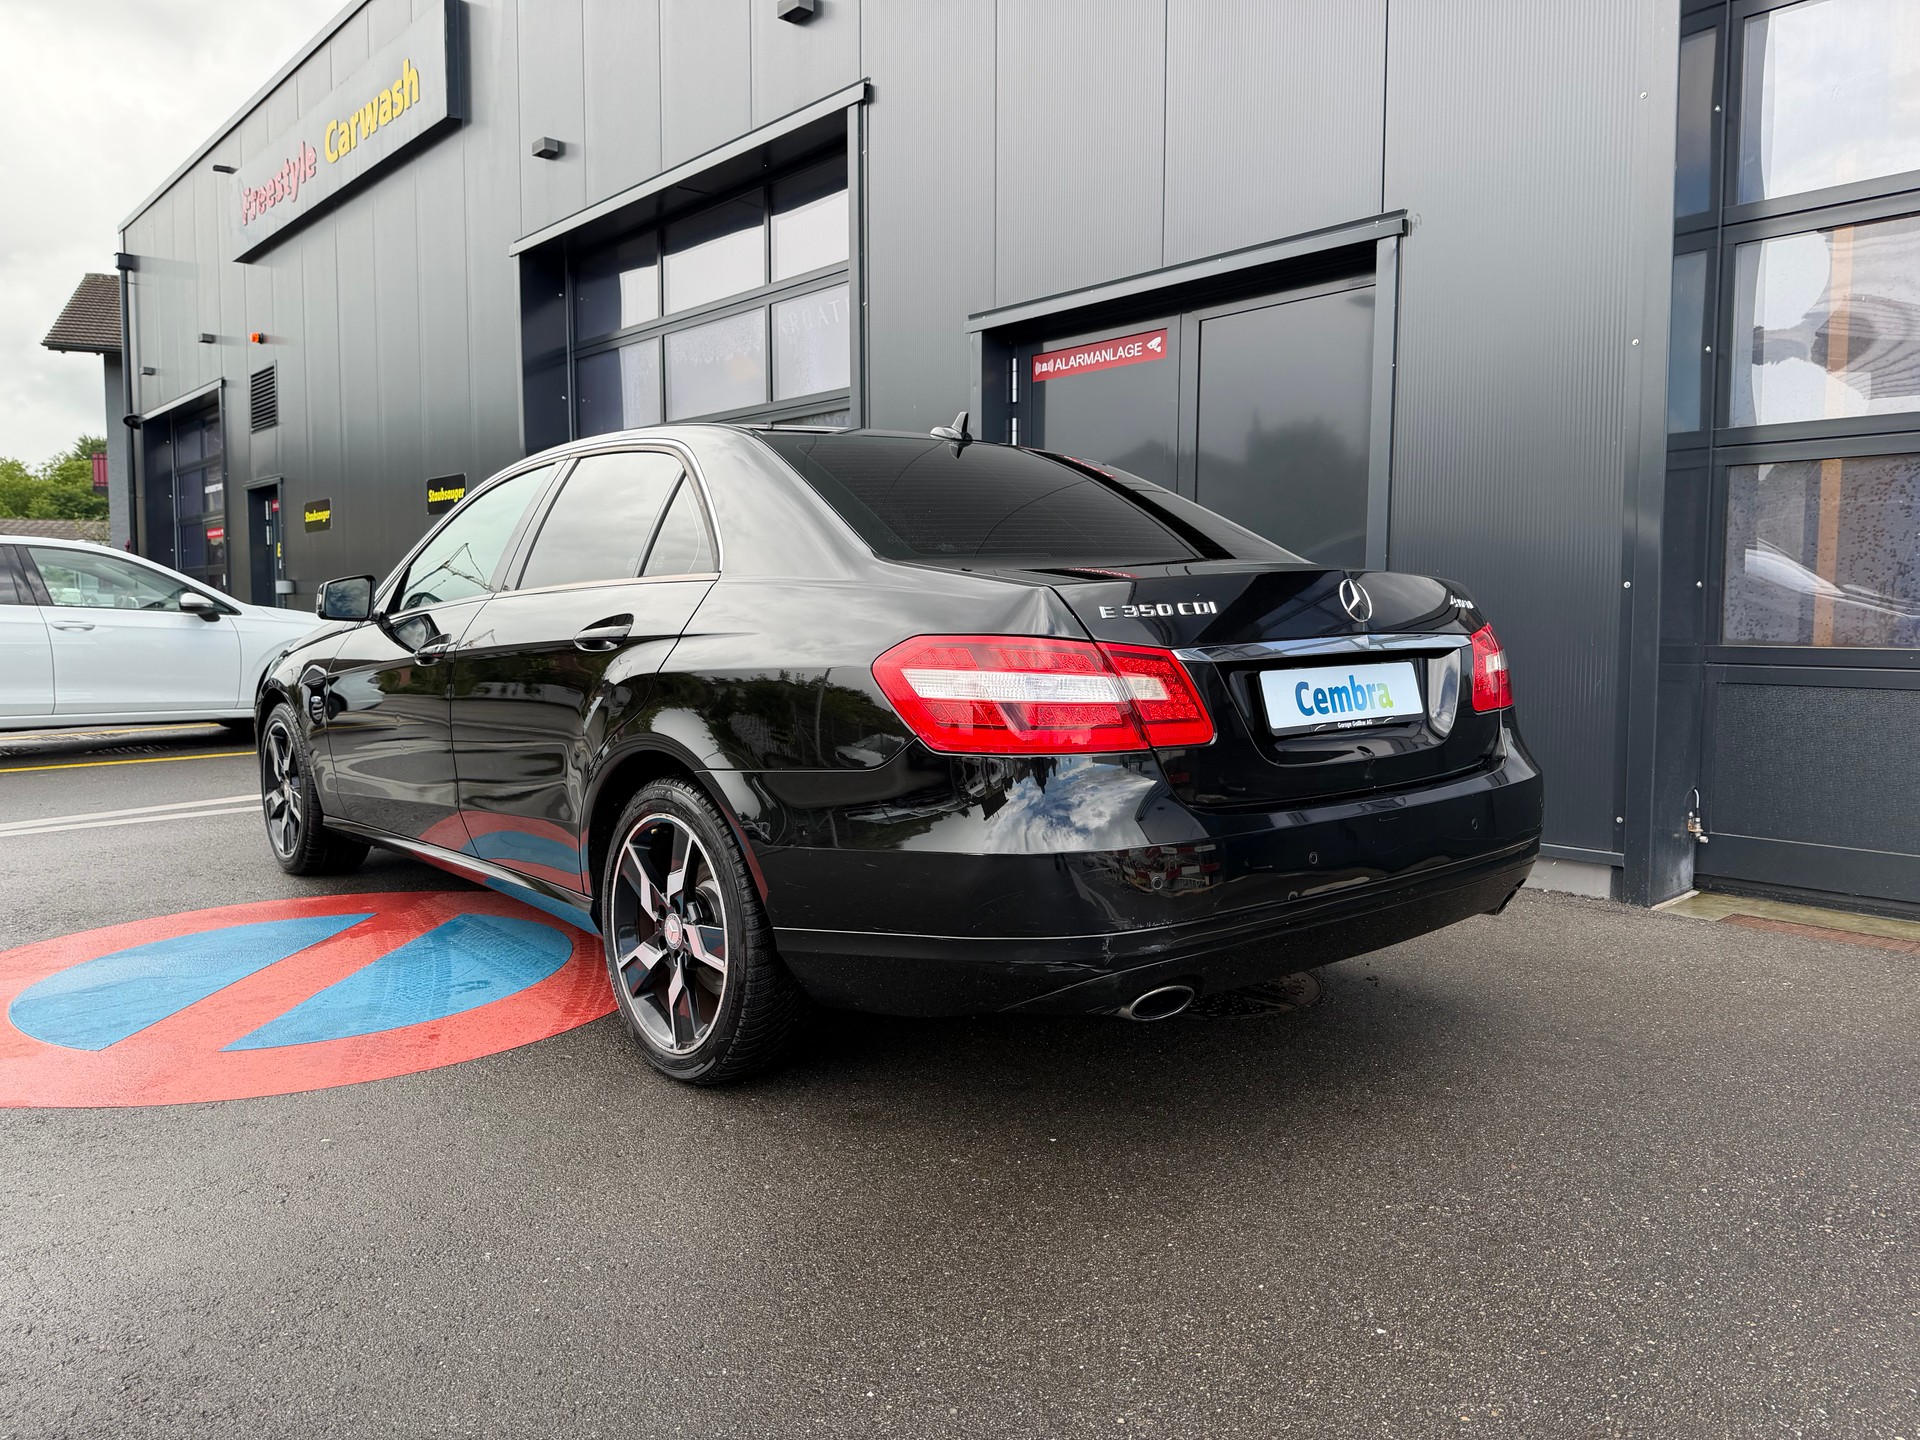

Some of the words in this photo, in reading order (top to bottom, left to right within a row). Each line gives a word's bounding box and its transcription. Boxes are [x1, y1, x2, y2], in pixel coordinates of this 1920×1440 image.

[243, 141, 317, 226] Freestyle
[325, 58, 421, 164] Carwash
[1054, 342, 1143, 372] ALARMANLAGE
[1099, 606, 1118, 619] E
[1121, 604, 1174, 618] 350
[1177, 601, 1217, 616] CDI
[1294, 675, 1394, 717] Cembra
